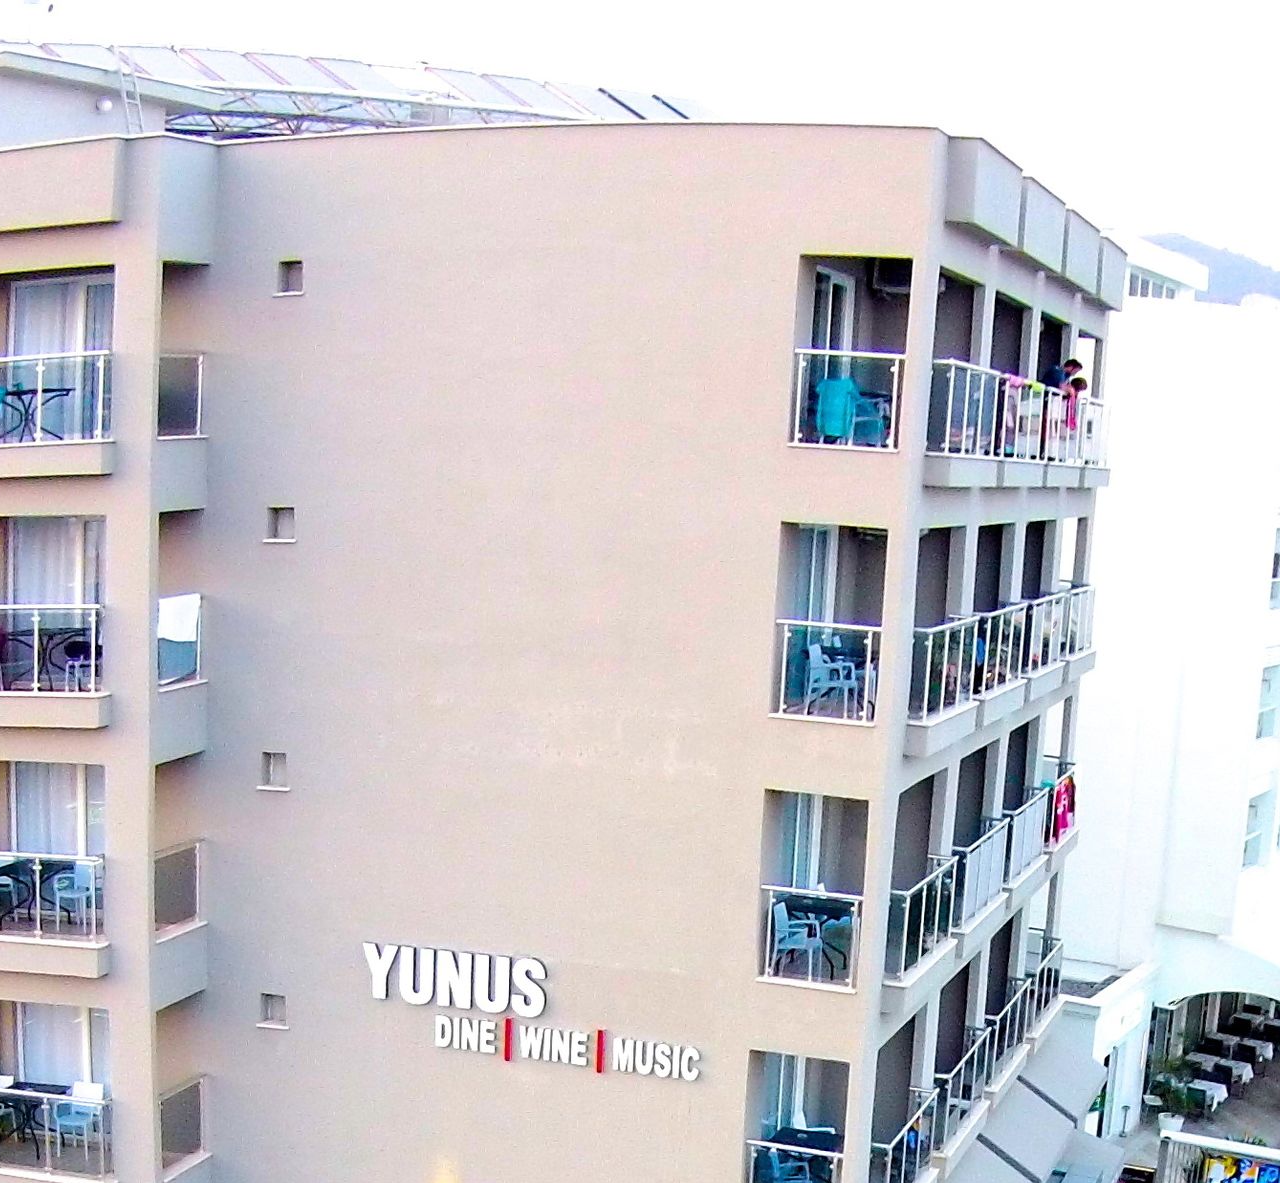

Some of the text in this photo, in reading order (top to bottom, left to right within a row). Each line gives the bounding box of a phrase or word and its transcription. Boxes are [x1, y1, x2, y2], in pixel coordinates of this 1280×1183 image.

[363, 941, 548, 1019] YUNUS
[434, 1014, 702, 1082] DINE WINE MUSIC
